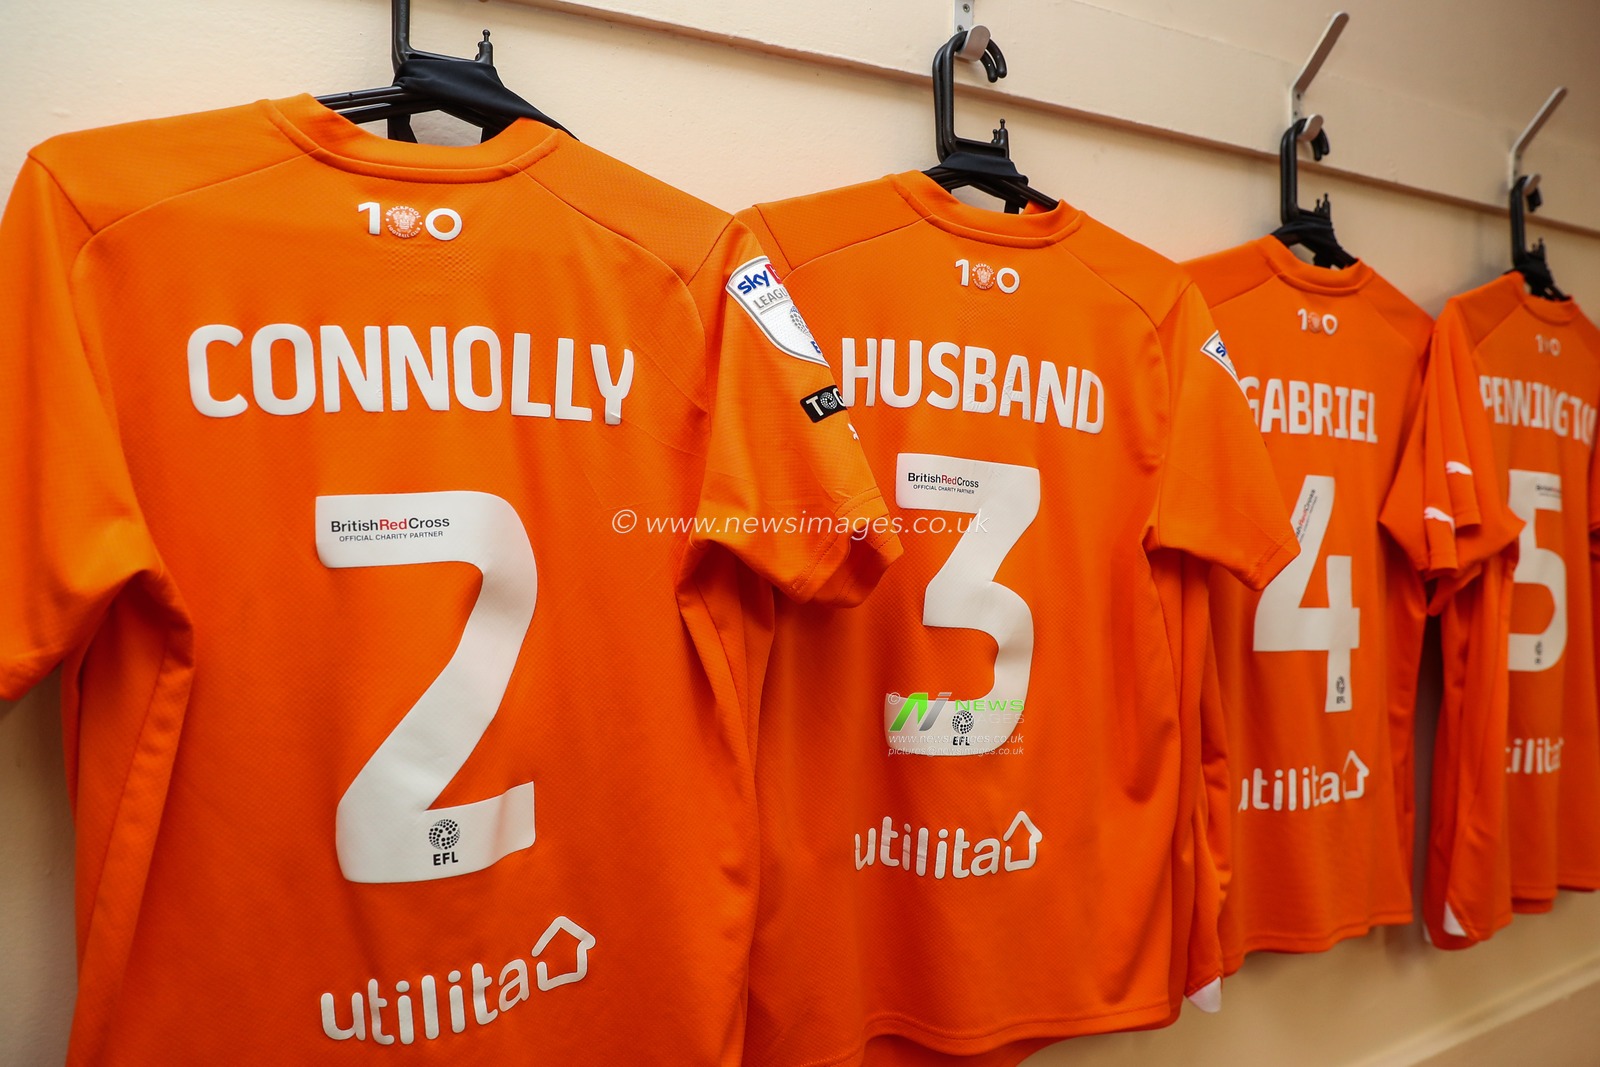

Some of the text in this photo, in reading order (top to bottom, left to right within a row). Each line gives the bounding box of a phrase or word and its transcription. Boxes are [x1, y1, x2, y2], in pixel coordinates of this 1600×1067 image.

[385, 205, 421, 219] BLACKPOOL
[737, 270, 770, 295] sky
[186, 322, 635, 425] CONNOLLY
[841, 337, 1105, 435] HUSBAND
[912, 483, 975, 495] OFFICIAL CHARITY PARTNER
[338, 530, 444, 543] OFFICIAL CHARITY PARTNER
[1507, 468, 1568, 672] 5
[884, 452, 1041, 757] 3
[1252, 474, 1361, 713] 4
[315, 490, 539, 884] 2
[951, 736, 971, 746] EFL
[432, 850, 459, 866] EFL
[854, 815, 1001, 880] utilita
[320, 957, 531, 1045] utilita
